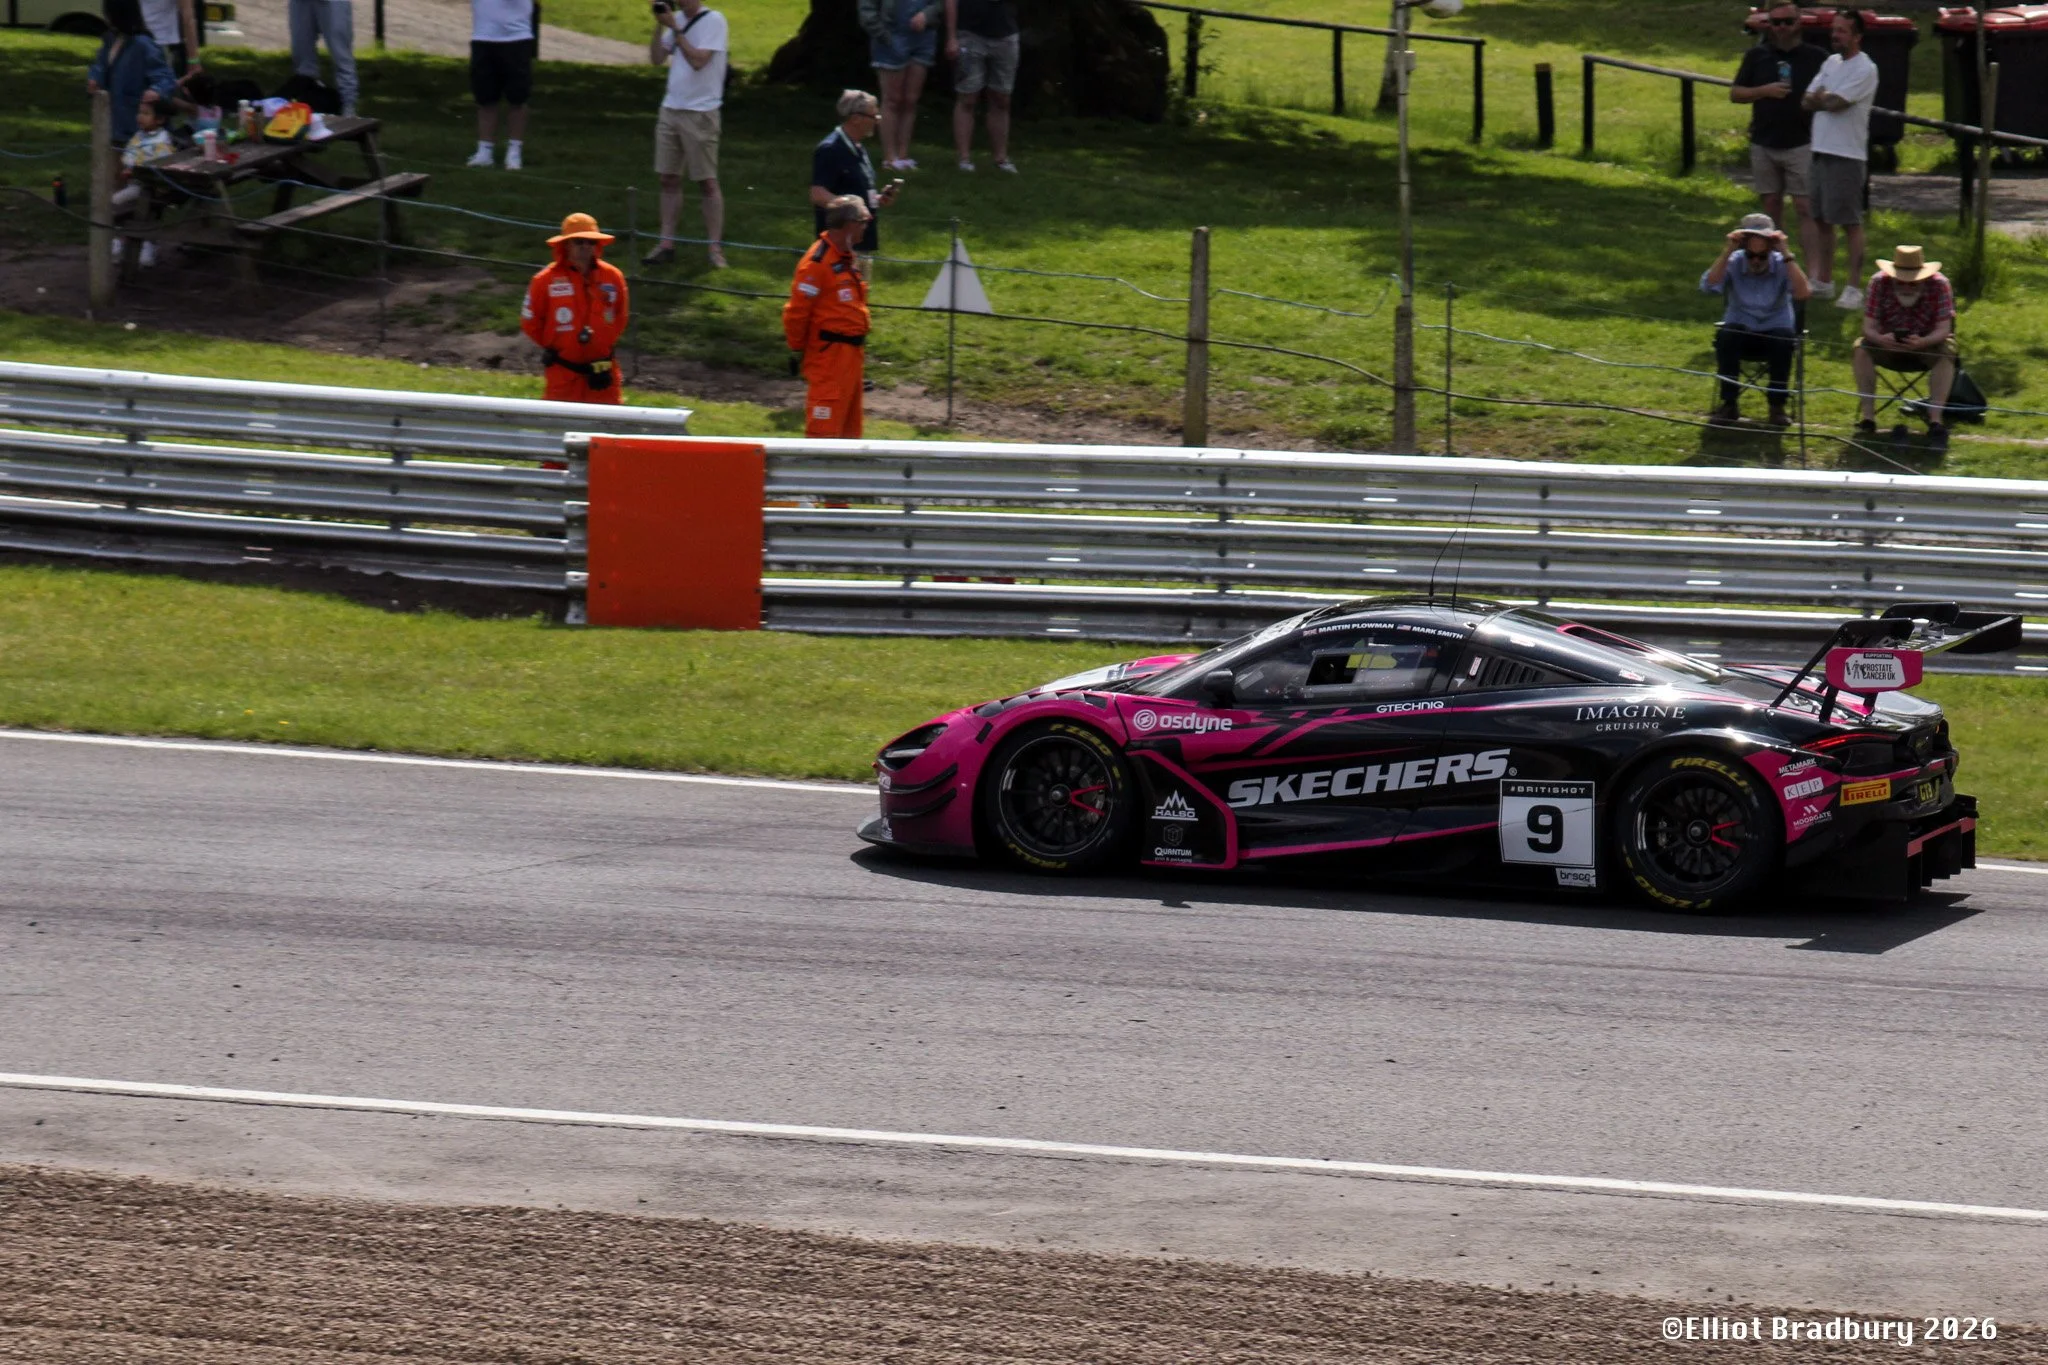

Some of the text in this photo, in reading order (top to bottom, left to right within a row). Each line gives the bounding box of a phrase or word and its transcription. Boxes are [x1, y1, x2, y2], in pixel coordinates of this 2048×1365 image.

[1318, 624, 1350, 633] MARTIN
[1412, 626, 1464, 639] MARK SMITH
[1862, 664, 1892, 672] PROSTATE
[1862, 672, 1896, 680] CANCER UK
[1376, 700, 1444, 713] GTECHNIQ
[1576, 705, 1686, 720] IMAGINE
[1160, 712, 1233, 734] osdyne
[1596, 722, 1660, 731] CRUISING
[1669, 757, 1748, 787] PIRELLI
[1778, 758, 1817, 774] METAMARK
[1227, 748, 1511, 808] SKECHERS
[1510, 786, 1586, 794] #BRITISHGT
[1843, 782, 1888, 801] PIRELLI
[1155, 809, 1196, 818] HALSO
[1793, 811, 1832, 826] MOORGATE
[1527, 804, 1564, 854] 9
